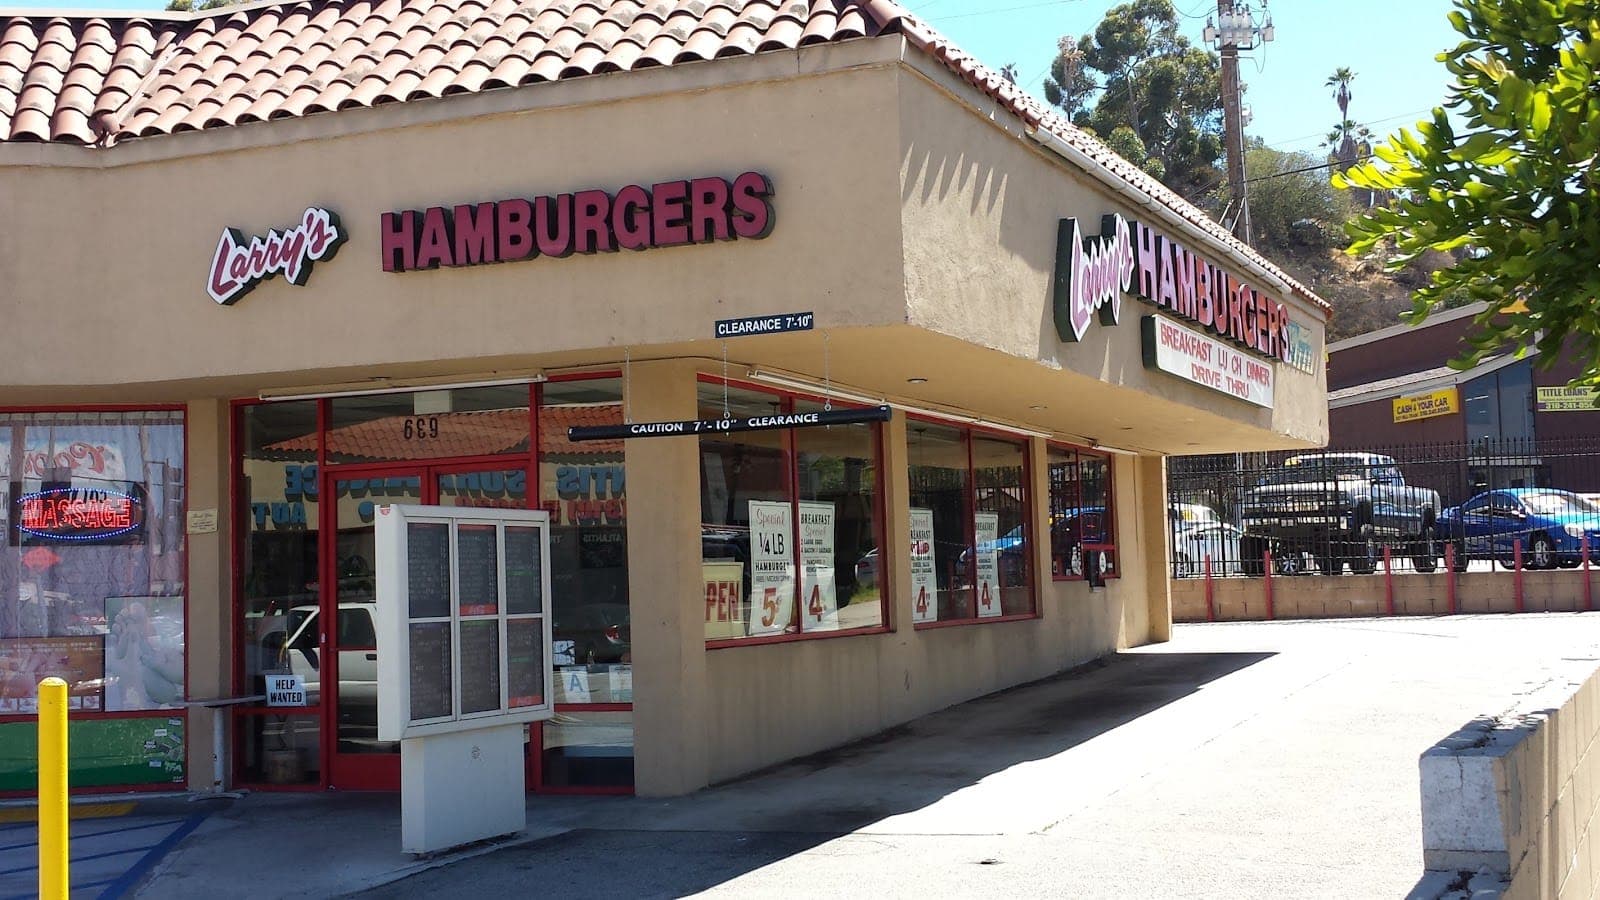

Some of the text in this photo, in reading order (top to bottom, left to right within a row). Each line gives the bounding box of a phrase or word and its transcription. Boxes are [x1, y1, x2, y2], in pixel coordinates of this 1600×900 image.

[381, 172, 772, 272] HAMBURGERS
[207, 208, 339, 304] Larry's
[1070, 213, 1134, 342] Larry's
[1136, 221, 1292, 363] HAMBURGERS
[718, 317, 781, 336] CLEARANCE
[1160, 323, 1213, 363] BREAKFAST
[1247, 361, 1271, 387] DINNER
[1190, 363, 1250, 398] DRIVE THRU
[1396, 404, 1413, 415] CASH
[1417, 400, 1434, 411] YOUR
[1434, 397, 1448, 407] CAR
[631, 422, 684, 435] CAUTION
[748, 413, 819, 428] CLEARANCE
[22, 498, 132, 529] MASSAGE
[756, 508, 785, 528] Special
[800, 513, 831, 526] BREAKFAST
[772, 532, 785, 555] LB
[911, 530, 931, 539] REAKFAST
[704, 580, 739, 621] PEN
[807, 584, 823, 622] 4
[275, 679, 296, 690] HELP
[569, 672, 584, 693] A
[270, 692, 303, 703] WANTED
